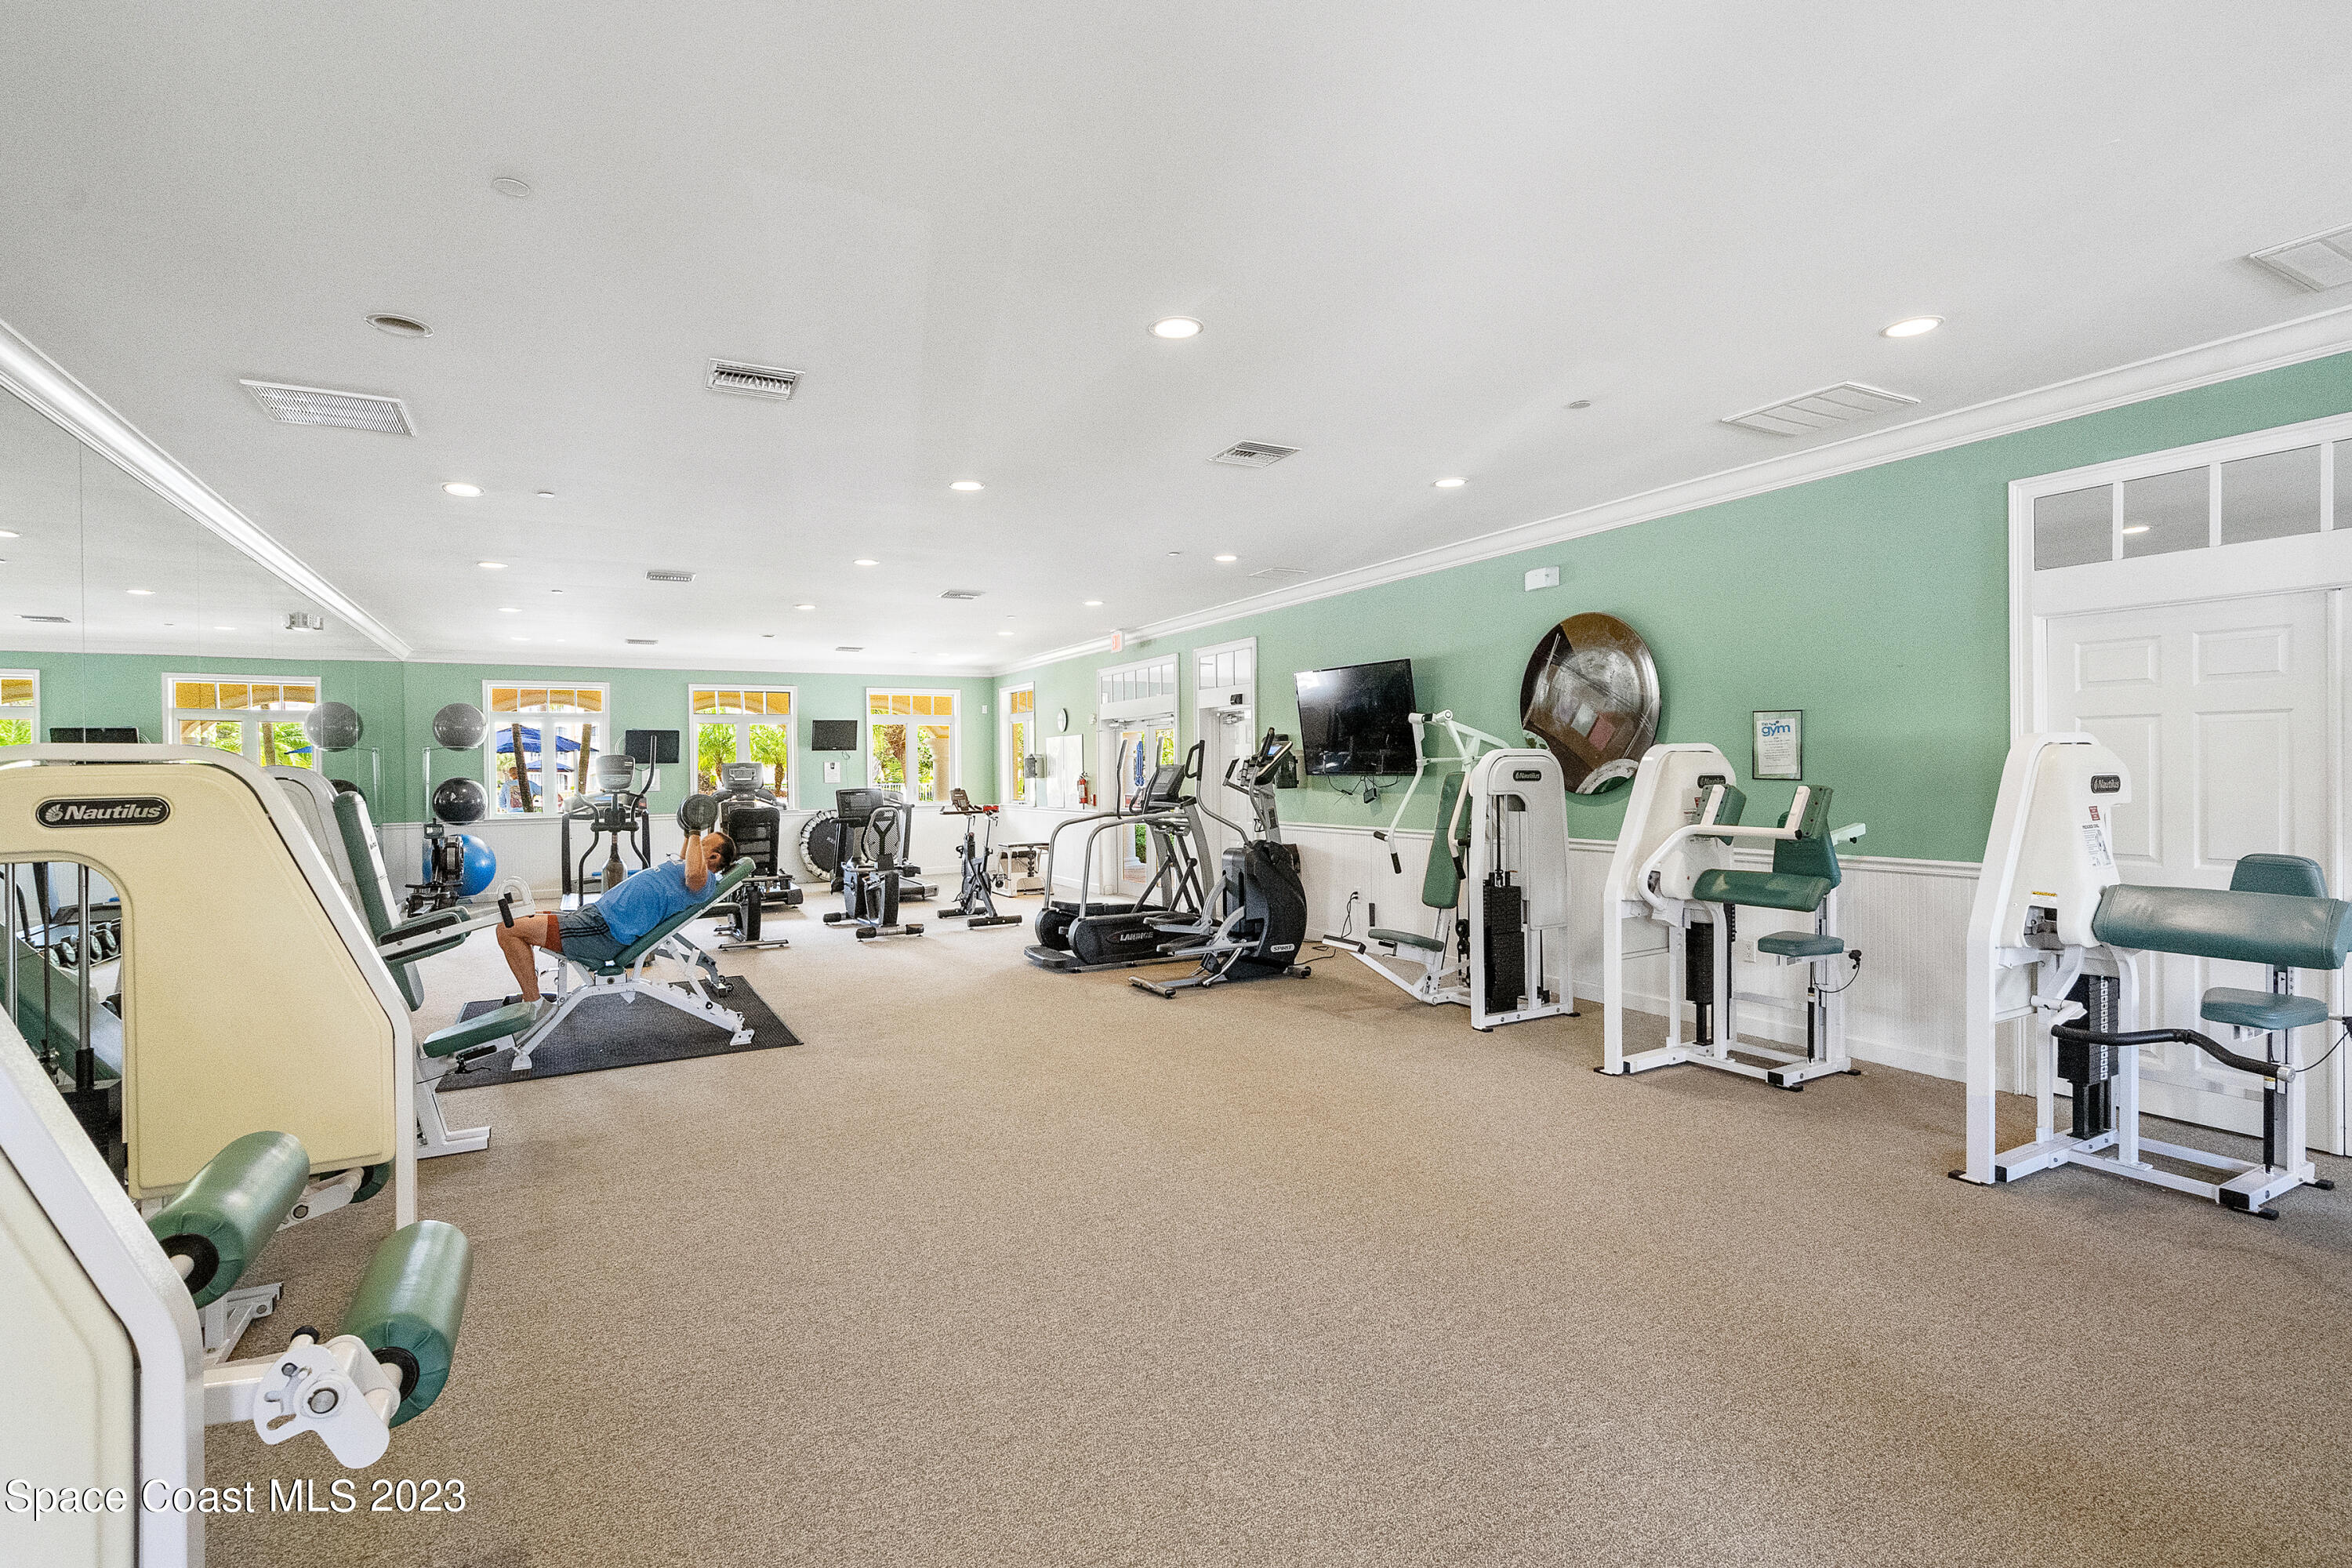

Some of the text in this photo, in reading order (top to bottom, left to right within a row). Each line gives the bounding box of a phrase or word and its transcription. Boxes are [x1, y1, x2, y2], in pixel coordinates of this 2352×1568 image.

[1762, 724, 1791, 736] gym
[2098, 779, 2119, 790] Nautilus
[64, 804, 162, 821] Nautilus
